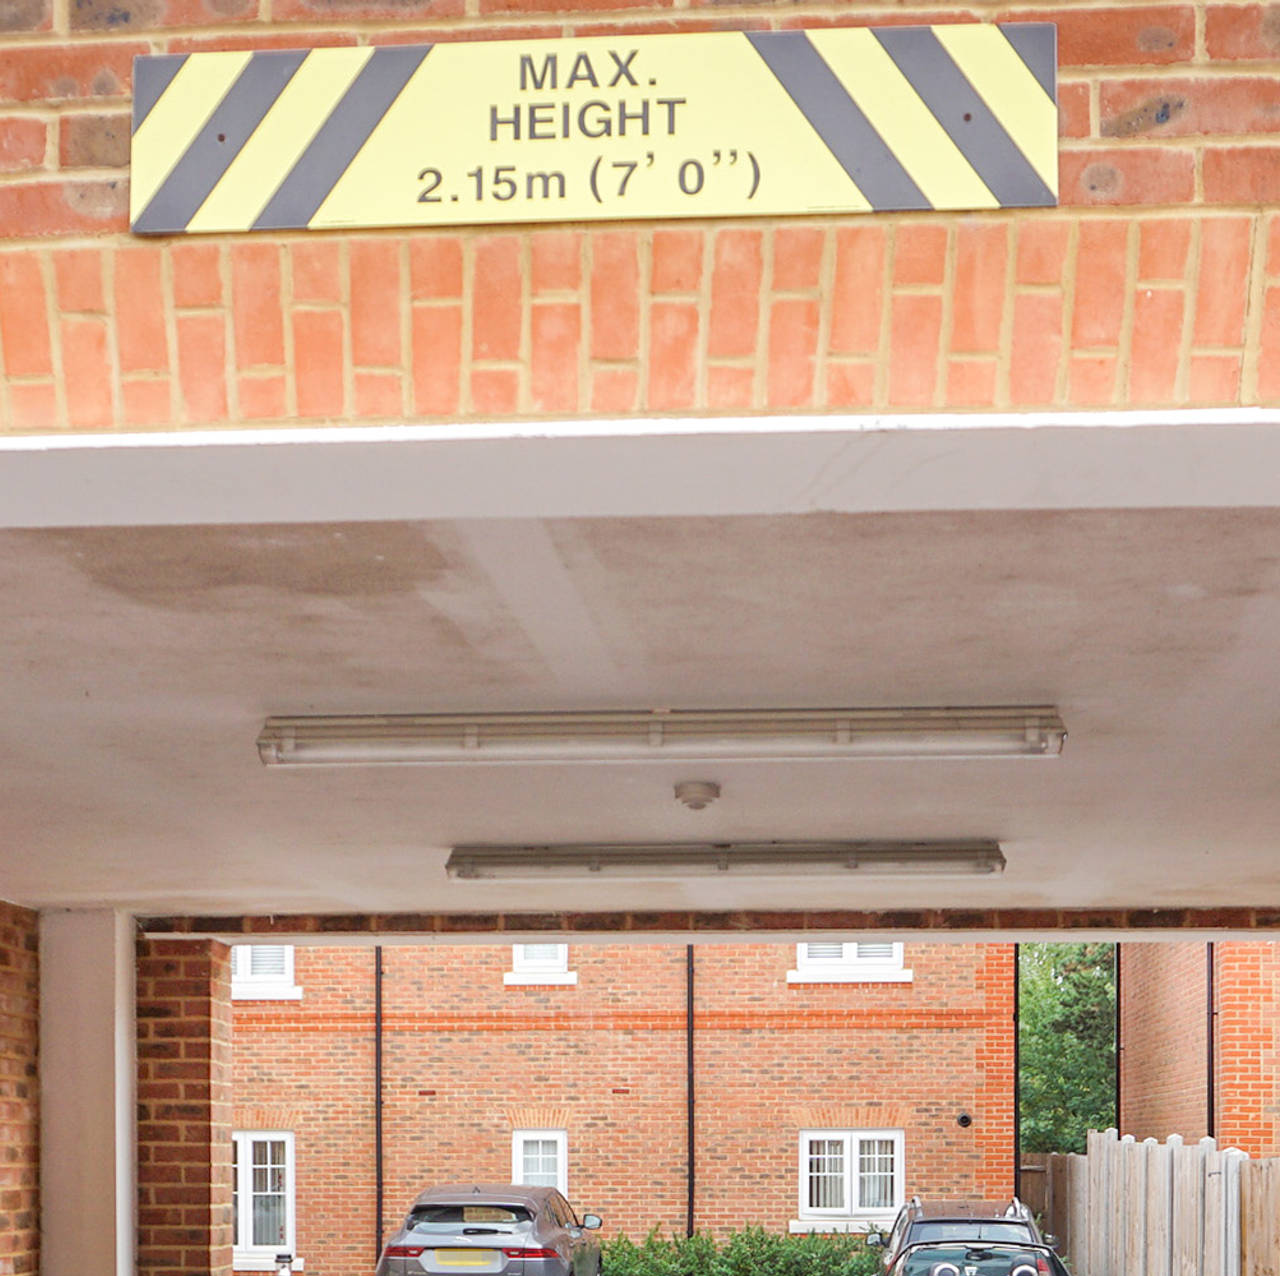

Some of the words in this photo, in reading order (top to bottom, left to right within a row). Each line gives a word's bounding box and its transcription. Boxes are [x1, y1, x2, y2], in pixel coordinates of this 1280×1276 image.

[519, 49, 658, 91] MAX.
[489, 97, 687, 142] HEIGHT
[416, 167, 567, 204] 2.15m
